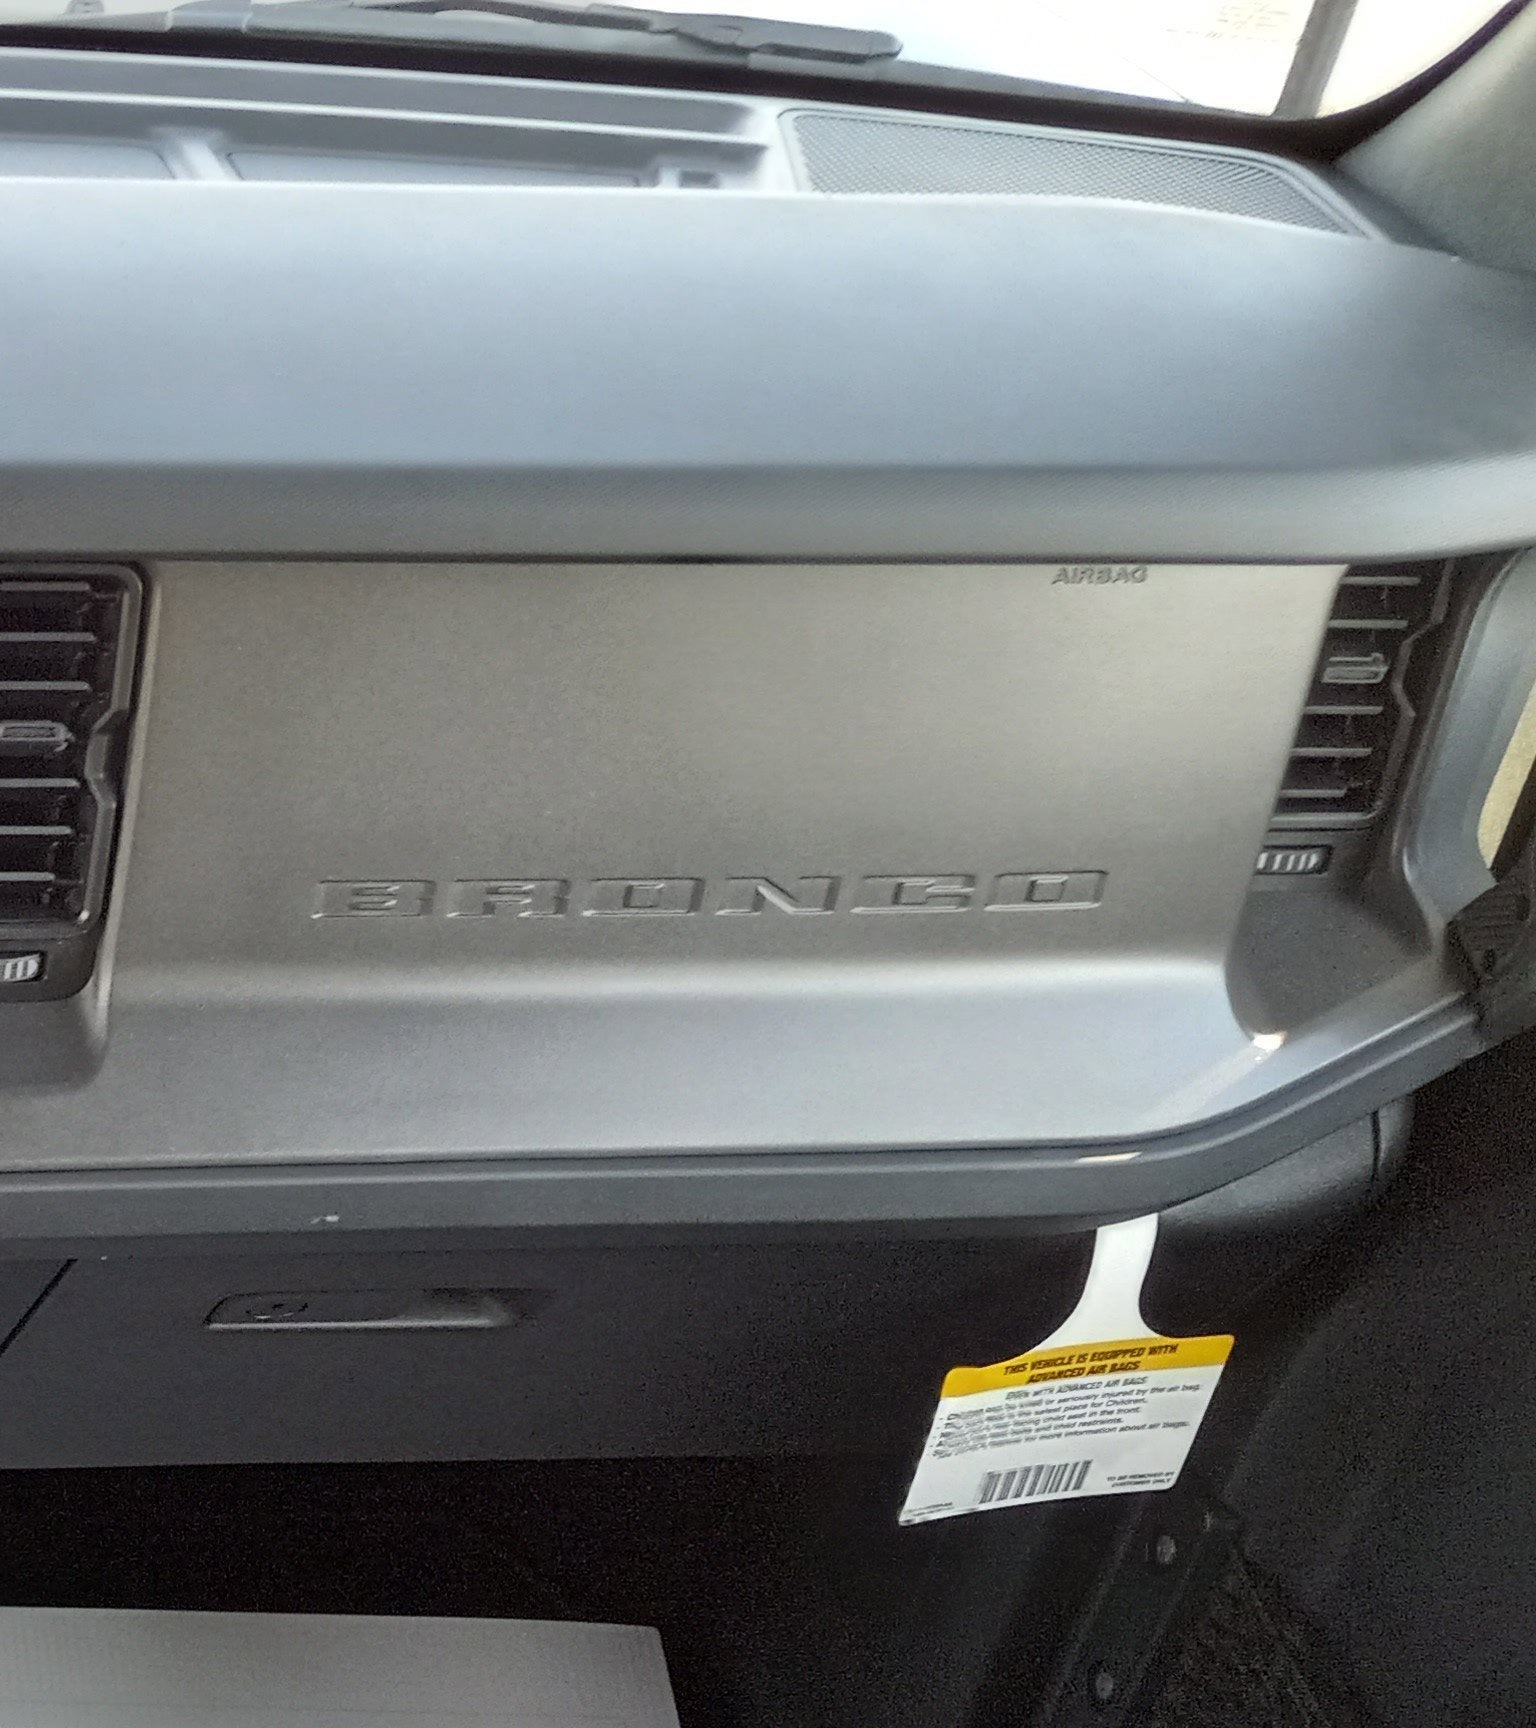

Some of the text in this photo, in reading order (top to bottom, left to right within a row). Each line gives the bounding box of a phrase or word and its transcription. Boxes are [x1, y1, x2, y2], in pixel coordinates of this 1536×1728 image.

[1051, 566, 1148, 585] AIRBAG
[311, 869, 1110, 918] BRONCO
[1003, 1344, 1178, 1376] THIS VEHICLE IS EQUIPPED WITH
[1027, 1361, 1141, 1384] ADVANCED AIR BAGS
